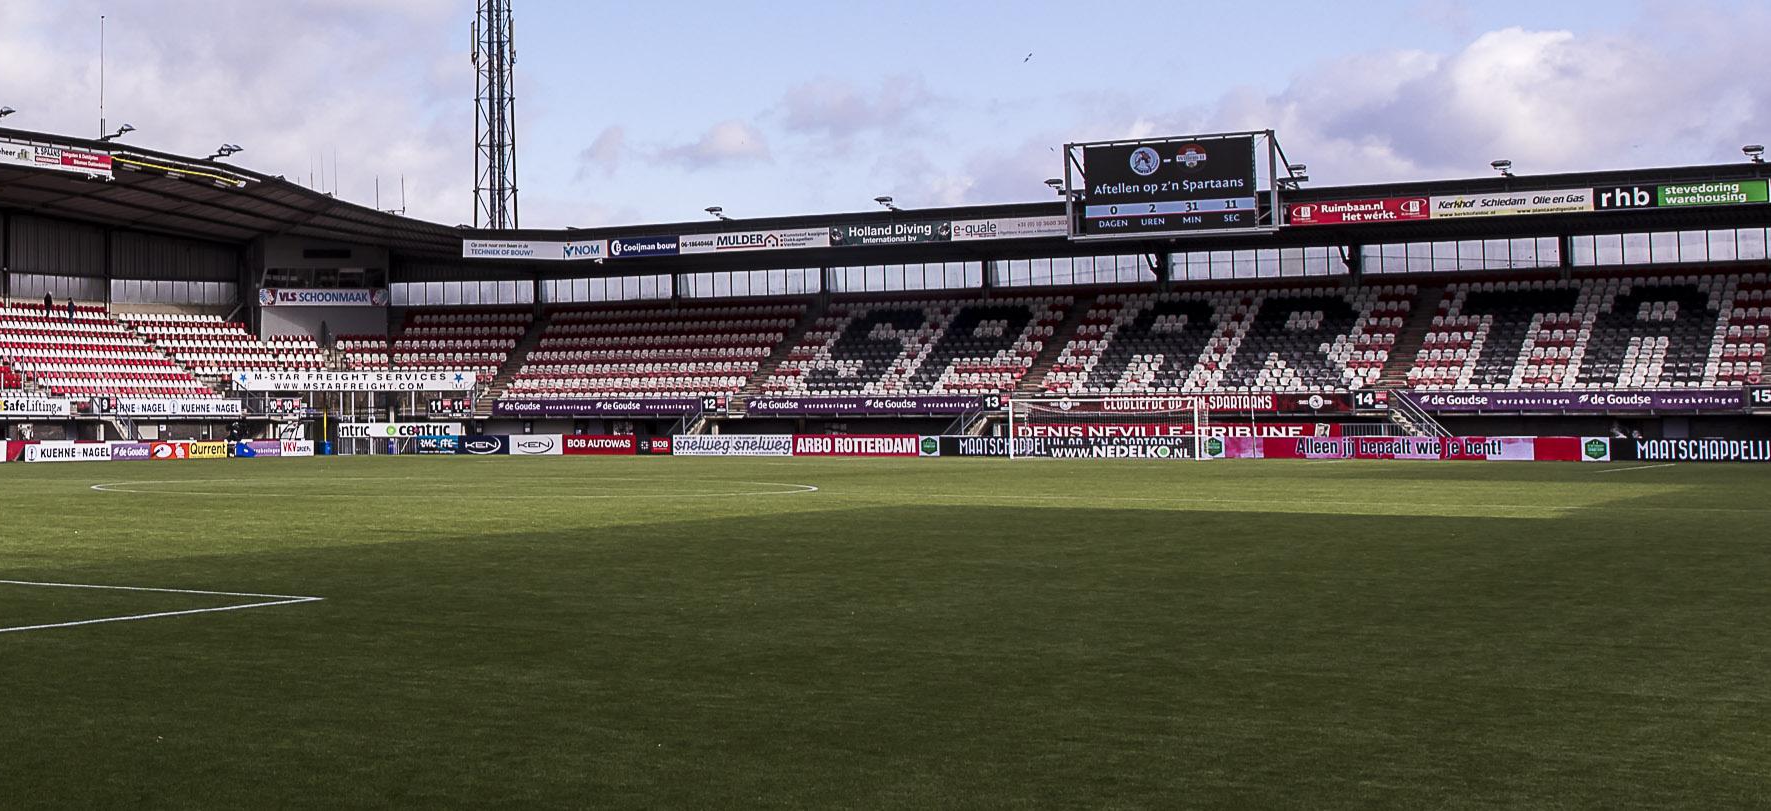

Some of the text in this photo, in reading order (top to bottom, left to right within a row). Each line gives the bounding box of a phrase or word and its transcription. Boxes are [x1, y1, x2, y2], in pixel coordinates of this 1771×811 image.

[1094, 178, 1244, 196] Aftellen op z'n Spartaans
[1665, 183, 1739, 195] stevedoring
[1438, 199, 1475, 210] Kerkhof
[1481, 197, 1526, 207] Schiedam
[1532, 195, 1551, 205] Olie
[1566, 194, 1584, 203] Gas
[1601, 187, 1650, 207] rhb
[1666, 190, 1746, 204] warehousing
[1110, 199, 1238, 215] 0 2 31 11
[1321, 201, 1384, 214] Ruimbaan.nl
[1099, 213, 1240, 229] DAGEN UREN MIN SEC
[1342, 211, 1361, 221] Het
[1364, 209, 1397, 220] wérkt.
[848, 222, 932, 236] Holland Diving
[953, 221, 997, 236] e-quale
[716, 233, 763, 247] MULDER
[862, 235, 916, 244] International bv
[511, 249, 533, 257] BOUW?
[623, 241, 676, 254] Cooijman bouw
[278, 291, 368, 303] VLS SCHOONMAAK
[255, 372, 446, 381] M-STAR FREIGHT SERVICES
[274, 383, 424, 391] WWW.MSTARFREIGHT.COM
[1356, 393, 1374, 405] 14
[1431, 394, 1569, 406] de Goudse verzekeringen
[1590, 394, 1739, 407] de Goudse verzekeringen
[1752, 389, 1771, 402] 15
[102, 400, 108, 411] 9
[269, 399, 277, 409] 10
[283, 400, 292, 410] 10
[431, 400, 441, 411] 11
[454, 400, 463, 410] 11
[504, 402, 513, 411] de
[514, 401, 540, 412] Goudse
[602, 401, 640, 411] de Goudse
[703, 399, 716, 409] 12
[758, 400, 767, 409] de
[768, 400, 799, 410] Goudse
[873, 399, 917, 409] de Goudse
[985, 397, 998, 408] 13
[1209, 396, 1272, 410] SPARTAANS
[1017, 425, 1083, 437] DENIS
[190, 442, 226, 456] Qurrent
[283, 442, 297, 453] VKV
[465, 441, 497, 449] KEN
[518, 441, 550, 449] KEN
[567, 438, 630, 449] BOB AUTOWAS
[652, 441, 668, 449] BOB
[675, 436, 791, 455] snelweg snelweg
[796, 437, 833, 453] ARBO
[834, 437, 916, 453] ROTTERDAM
[1296, 437, 1502, 460] Alleen jij bepaalt wie je bent!
[118, 446, 149, 457] de Goudse
